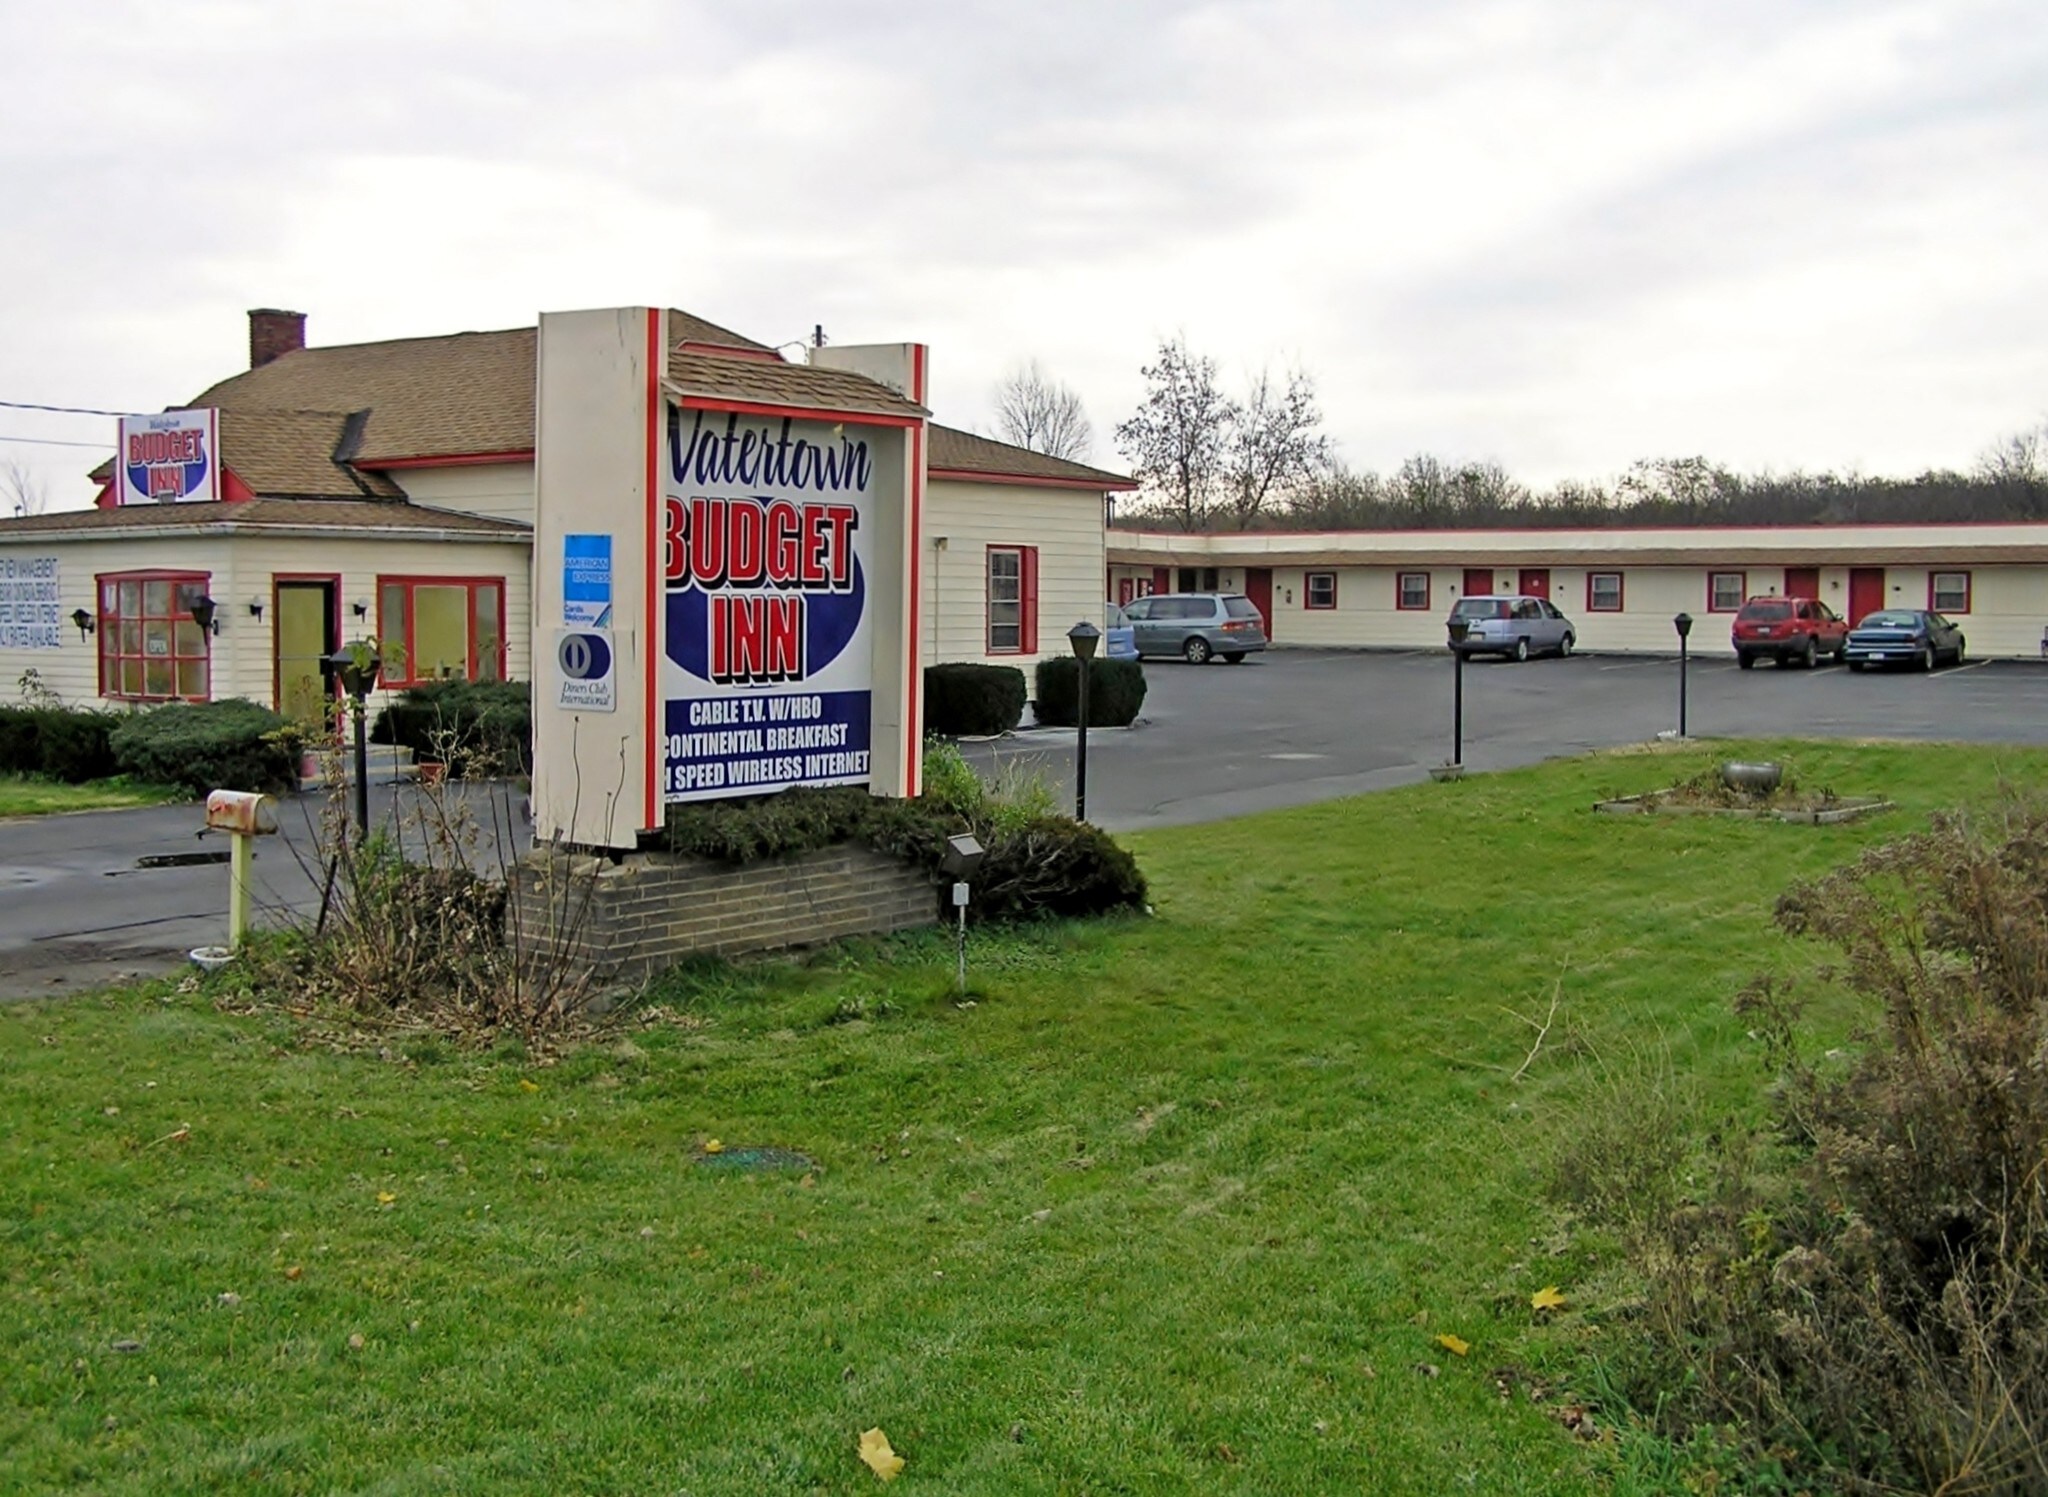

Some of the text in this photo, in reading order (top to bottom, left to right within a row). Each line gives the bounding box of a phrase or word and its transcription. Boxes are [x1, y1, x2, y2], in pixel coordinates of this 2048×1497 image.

[130, 430, 204, 465] BUDGET
[150, 467, 184, 498] INN
[667, 496, 859, 589] BUDGET
[565, 558, 608, 569] AMERICAN
[573, 571, 611, 584] EXPRESS
[564, 613, 595, 621] Welcome
[150, 640, 167, 653] OPEN
[710, 594, 805, 686] INN
[561, 692, 611, 705] International
[563, 681, 608, 694] Diners Club
[690, 696, 822, 726] CABLE T.V. W/HBO
[767, 724, 848, 752] BREAKFAST
[675, 762, 725, 790] SPEED
[727, 755, 802, 785] WIRELESS
[805, 750, 870, 777] INTERNET
